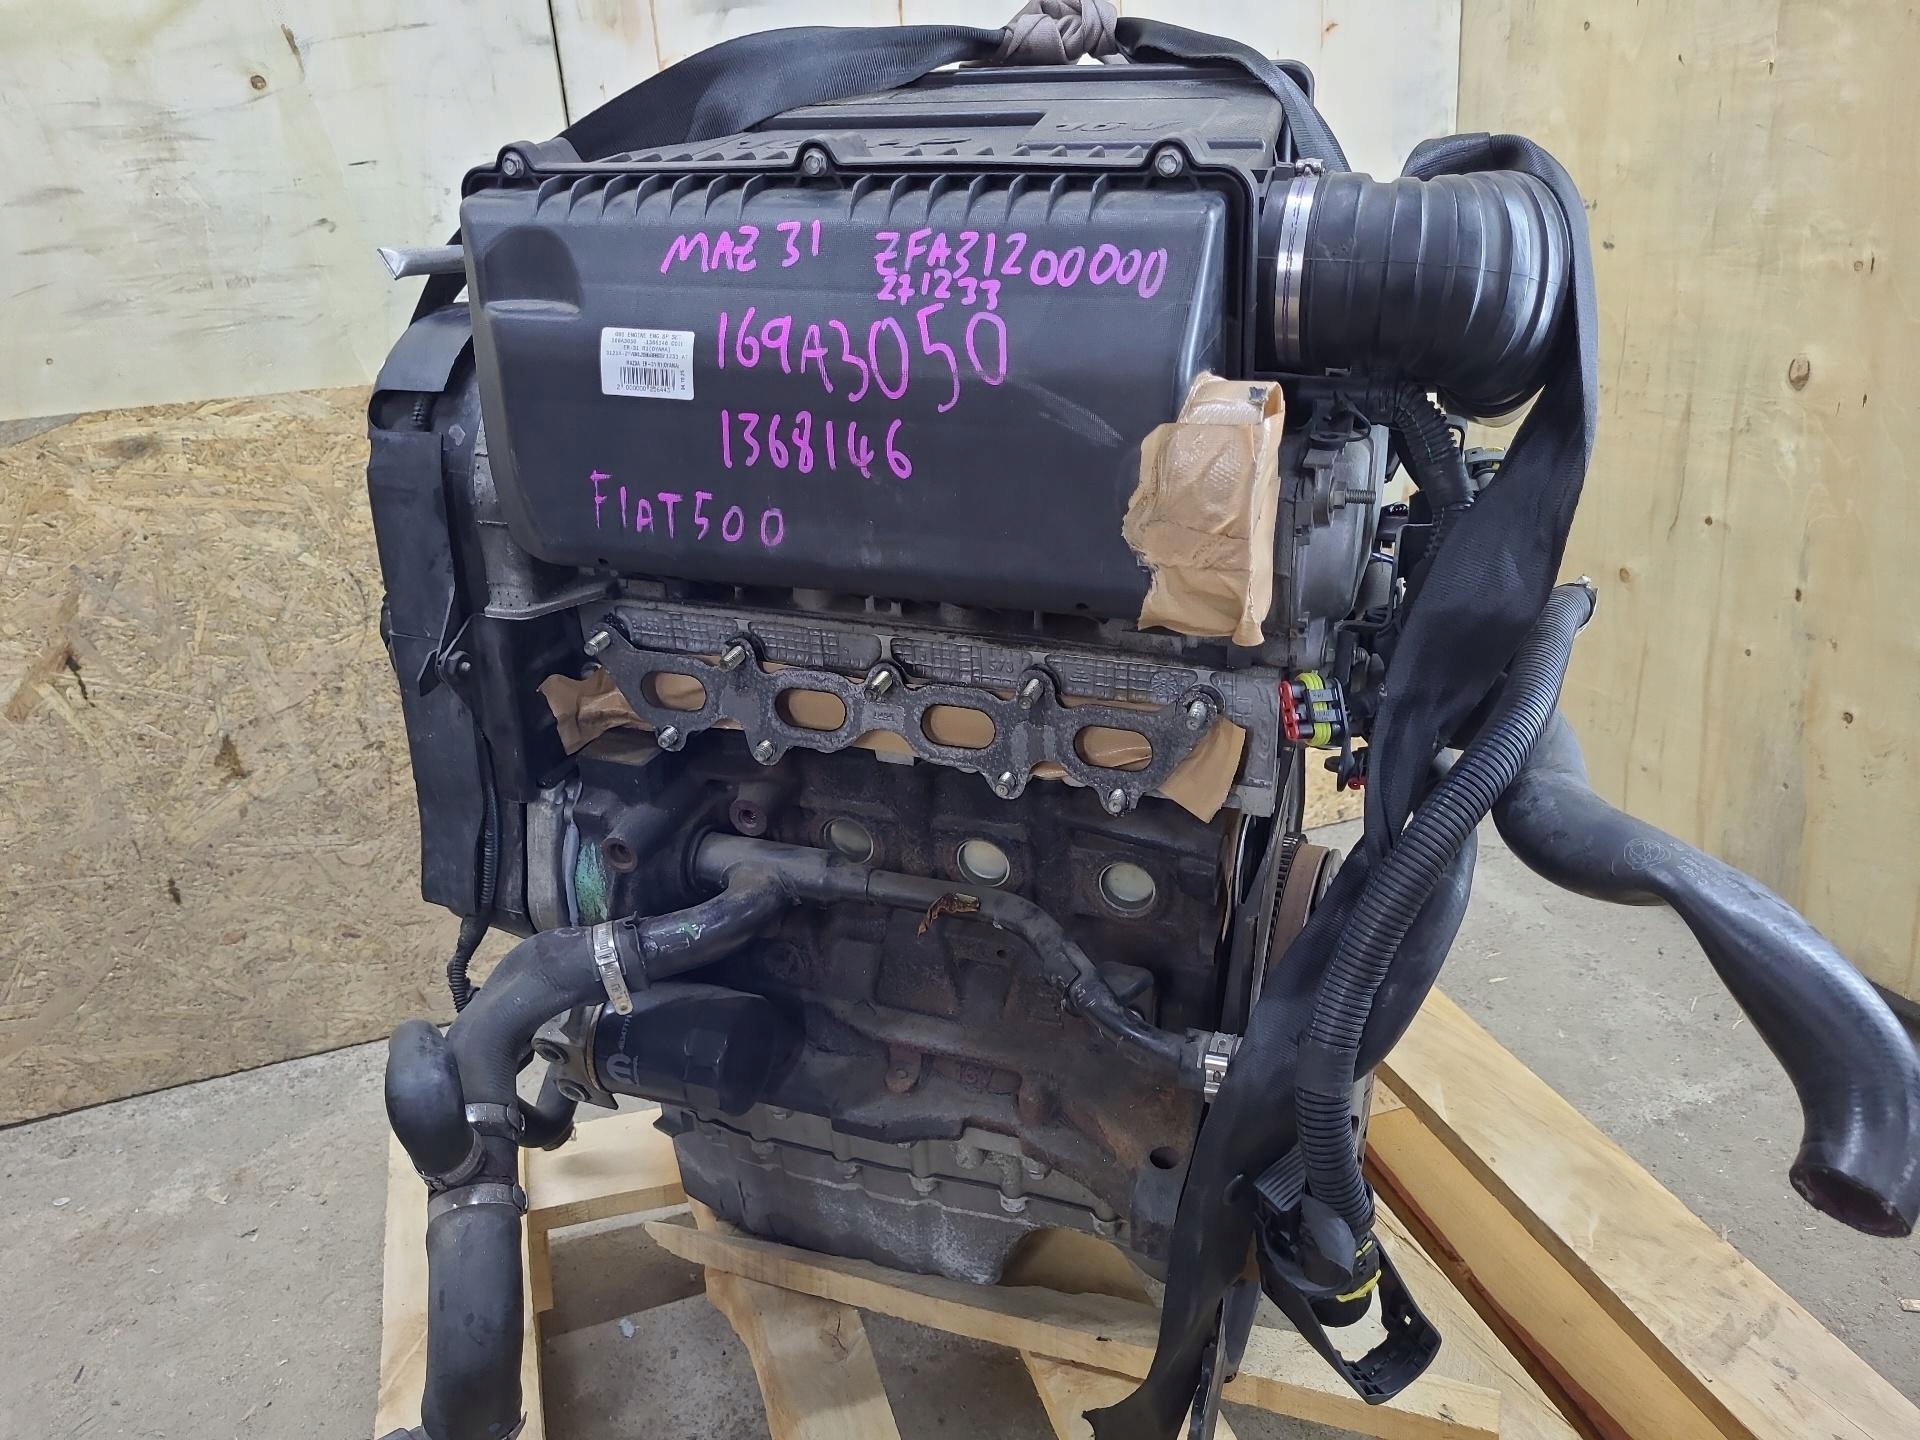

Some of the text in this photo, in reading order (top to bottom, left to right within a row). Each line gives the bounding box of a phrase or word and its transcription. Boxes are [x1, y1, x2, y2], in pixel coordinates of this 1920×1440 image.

[660, 220, 822, 274] MAZ 31
[874, 227, 1168, 299] ZFA31200000
[716, 303, 1007, 413] 169A3050
[720, 409, 913, 479] 1368146
